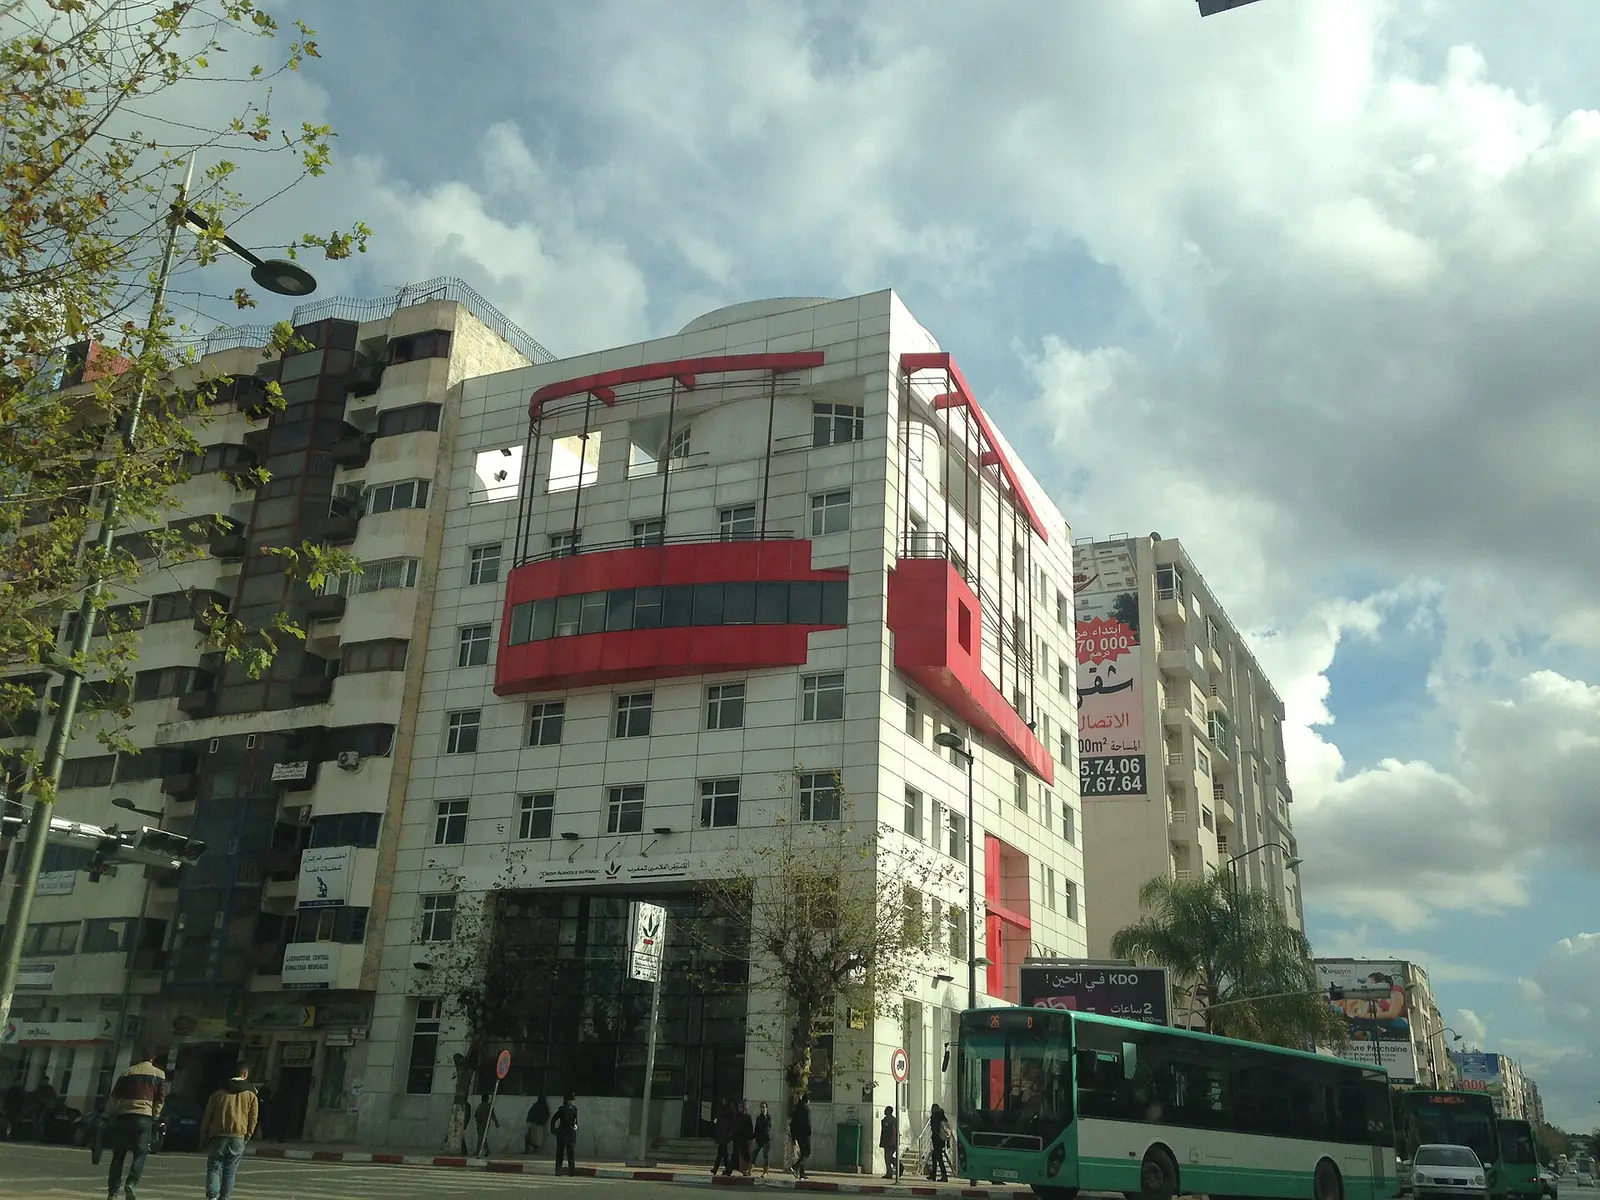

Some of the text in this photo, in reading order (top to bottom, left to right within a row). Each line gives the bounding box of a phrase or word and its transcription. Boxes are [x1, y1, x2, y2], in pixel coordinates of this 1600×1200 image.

[1092, 624, 1121, 637] ابتداء
[1100, 636, 1128, 650] 000
[1089, 650, 1111, 660] درهم
[1078, 712, 1129, 733] الاتصال
[1080, 757, 1140, 776] 5.74.06
[1081, 775, 1142, 793] 7.67.64
[1052, 972, 1082, 988] الحين
[1085, 972, 1105, 992] في
[1109, 974, 1139, 985] KDO
